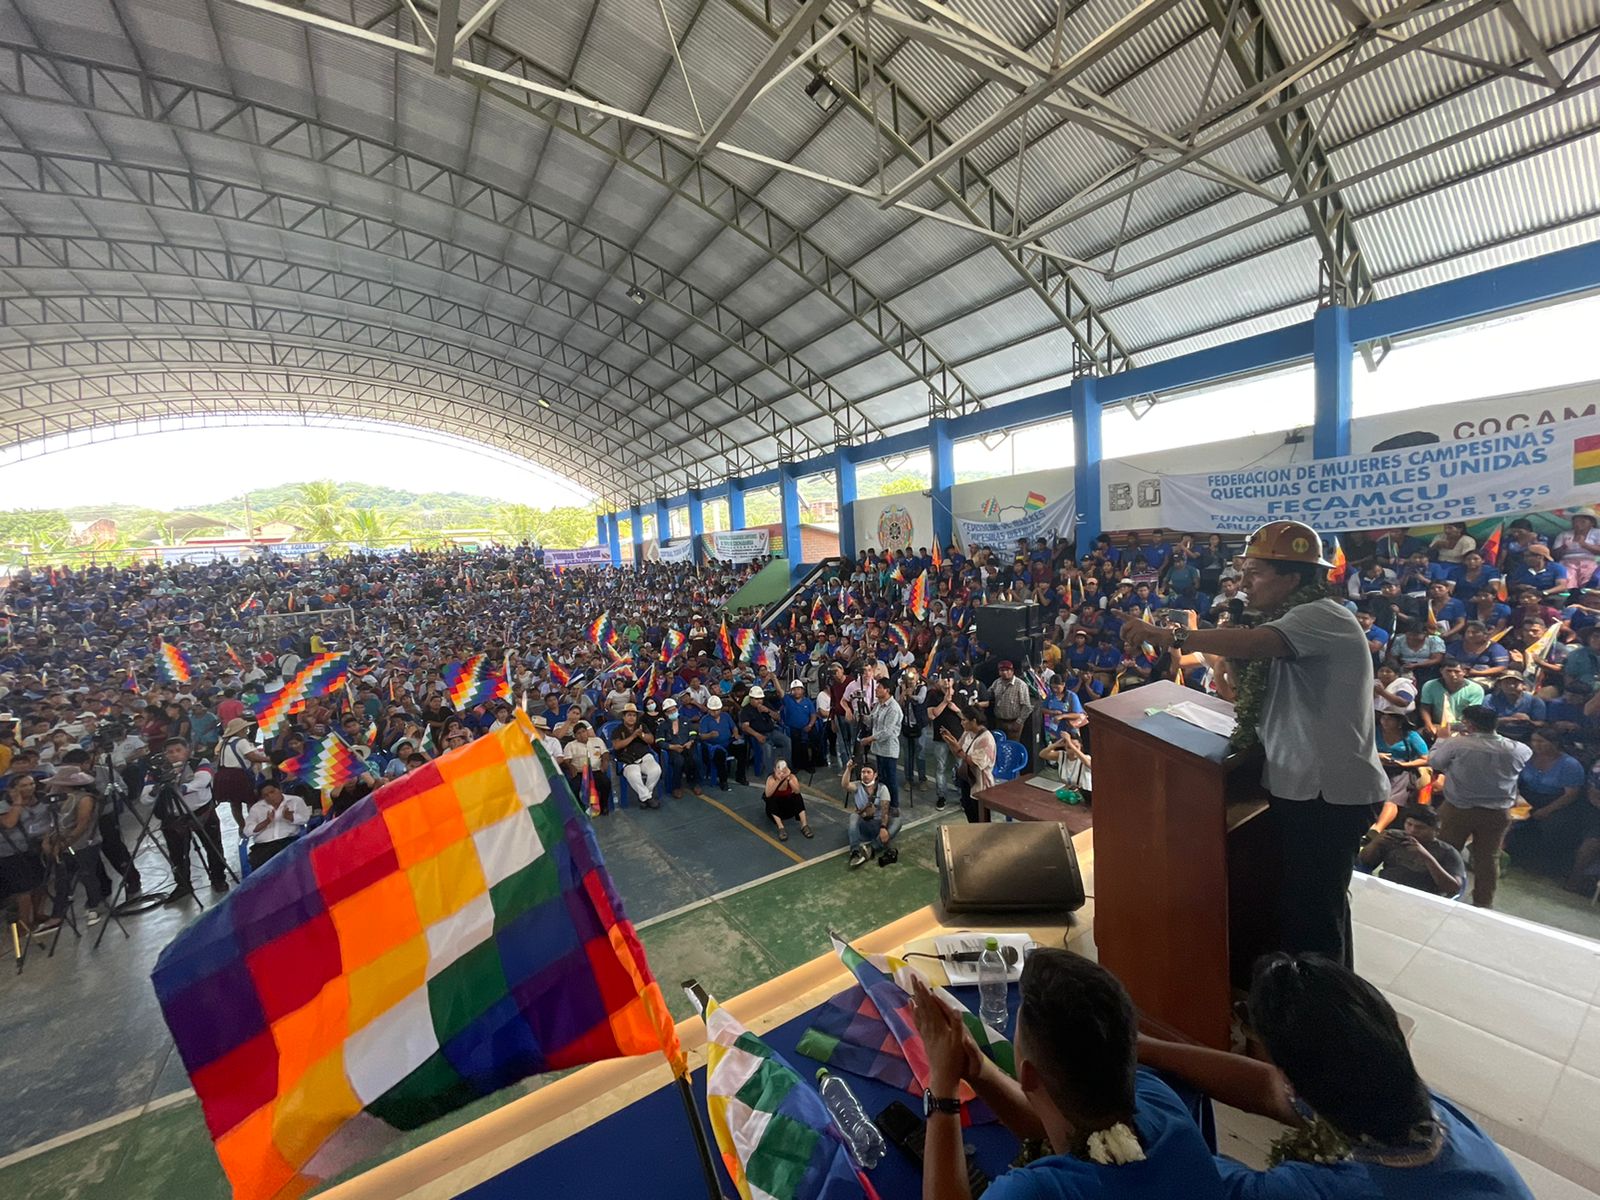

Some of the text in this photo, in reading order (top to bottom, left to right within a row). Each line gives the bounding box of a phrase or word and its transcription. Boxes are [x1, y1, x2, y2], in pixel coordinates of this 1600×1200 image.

[1208, 428, 1555, 487] FEDERACION DE MUJERES CAMPESINAS
[1210, 448, 1548, 500] QUECHUAS CENTRALES UNIDAS
[1267, 484, 1448, 514] FECAMCU
[1300, 513, 1321, 522] 17
[1334, 509, 1360, 519] DE
[1367, 502, 1434, 517] JULIO
[1444, 496, 1476, 508] DE
[1488, 485, 1551, 502] 1995
[1356, 511, 1451, 527] CNMCIO
